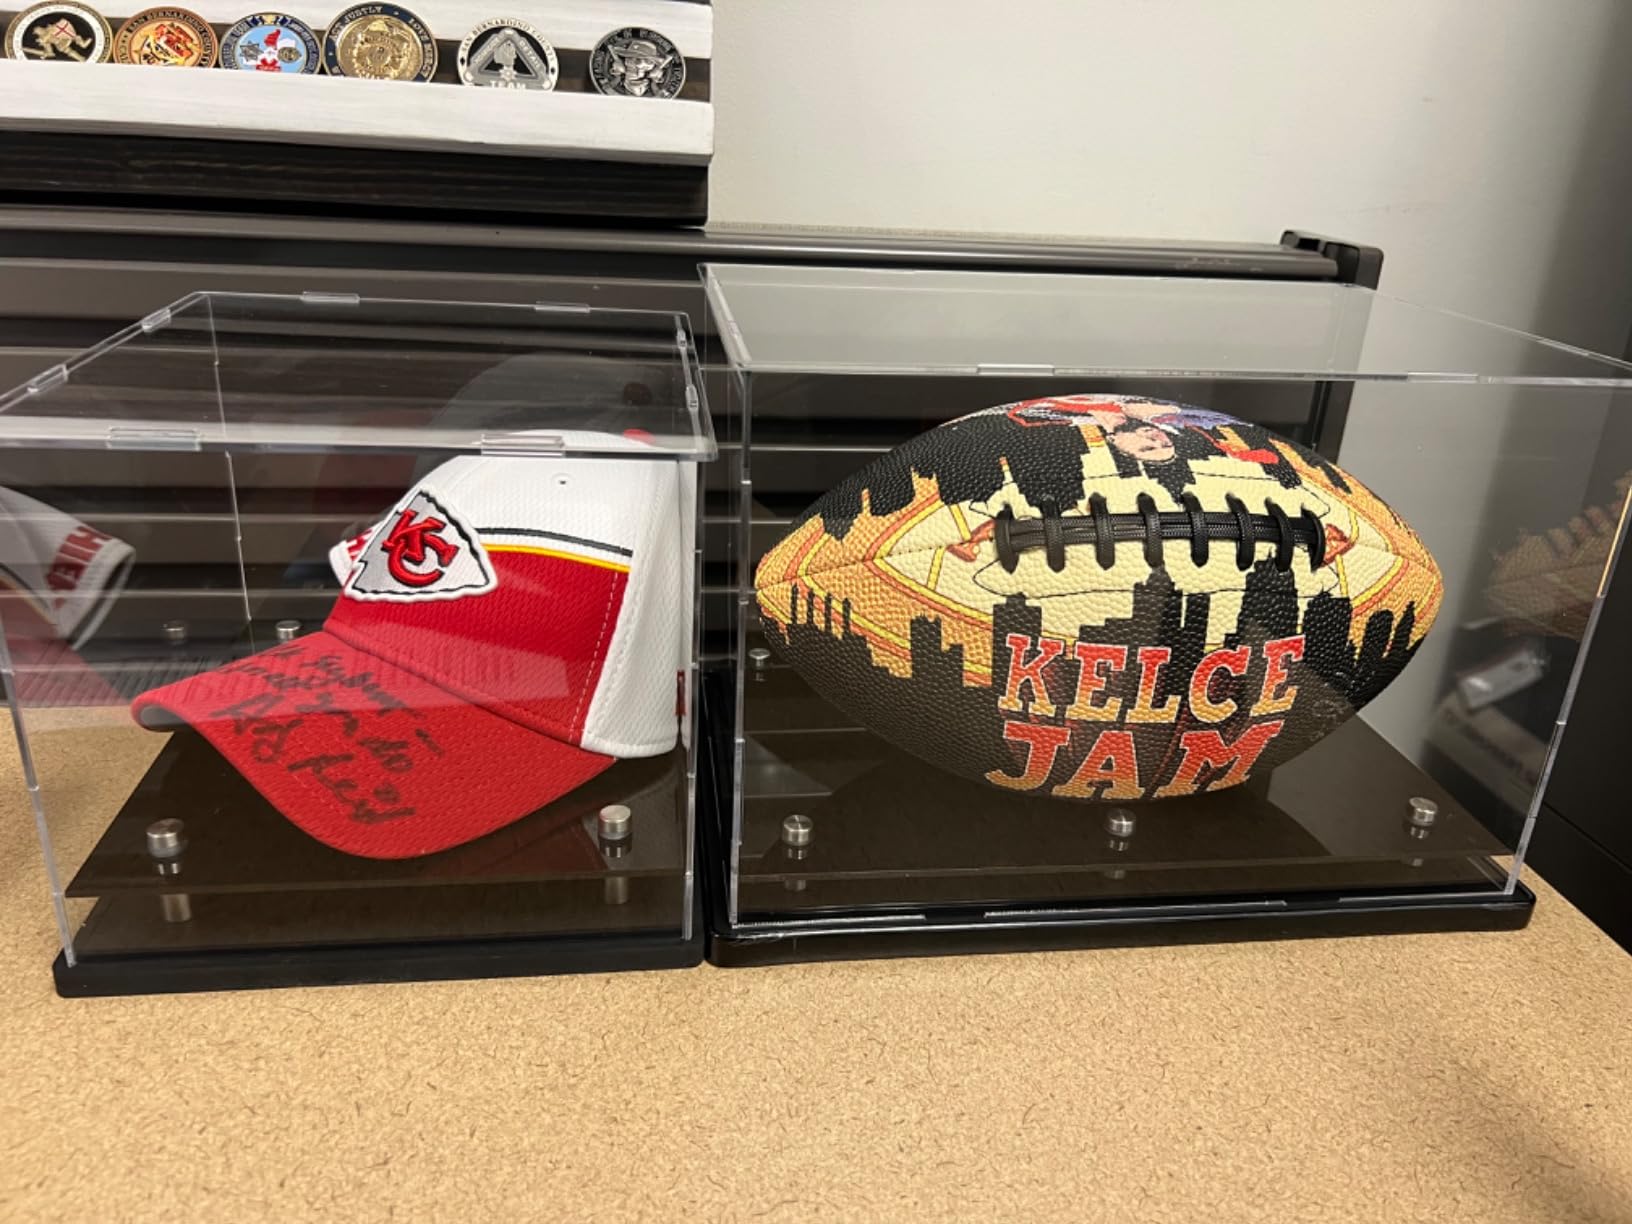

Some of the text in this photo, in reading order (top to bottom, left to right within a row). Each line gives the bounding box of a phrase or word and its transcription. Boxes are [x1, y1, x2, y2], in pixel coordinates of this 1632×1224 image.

[344, 6, 384, 23] JUSTLY
[472, 18, 531, 36] BERNARDINO
[381, 509, 460, 588] KC
[997, 633, 1306, 724] KELCE
[984, 719, 1285, 800] JAM
